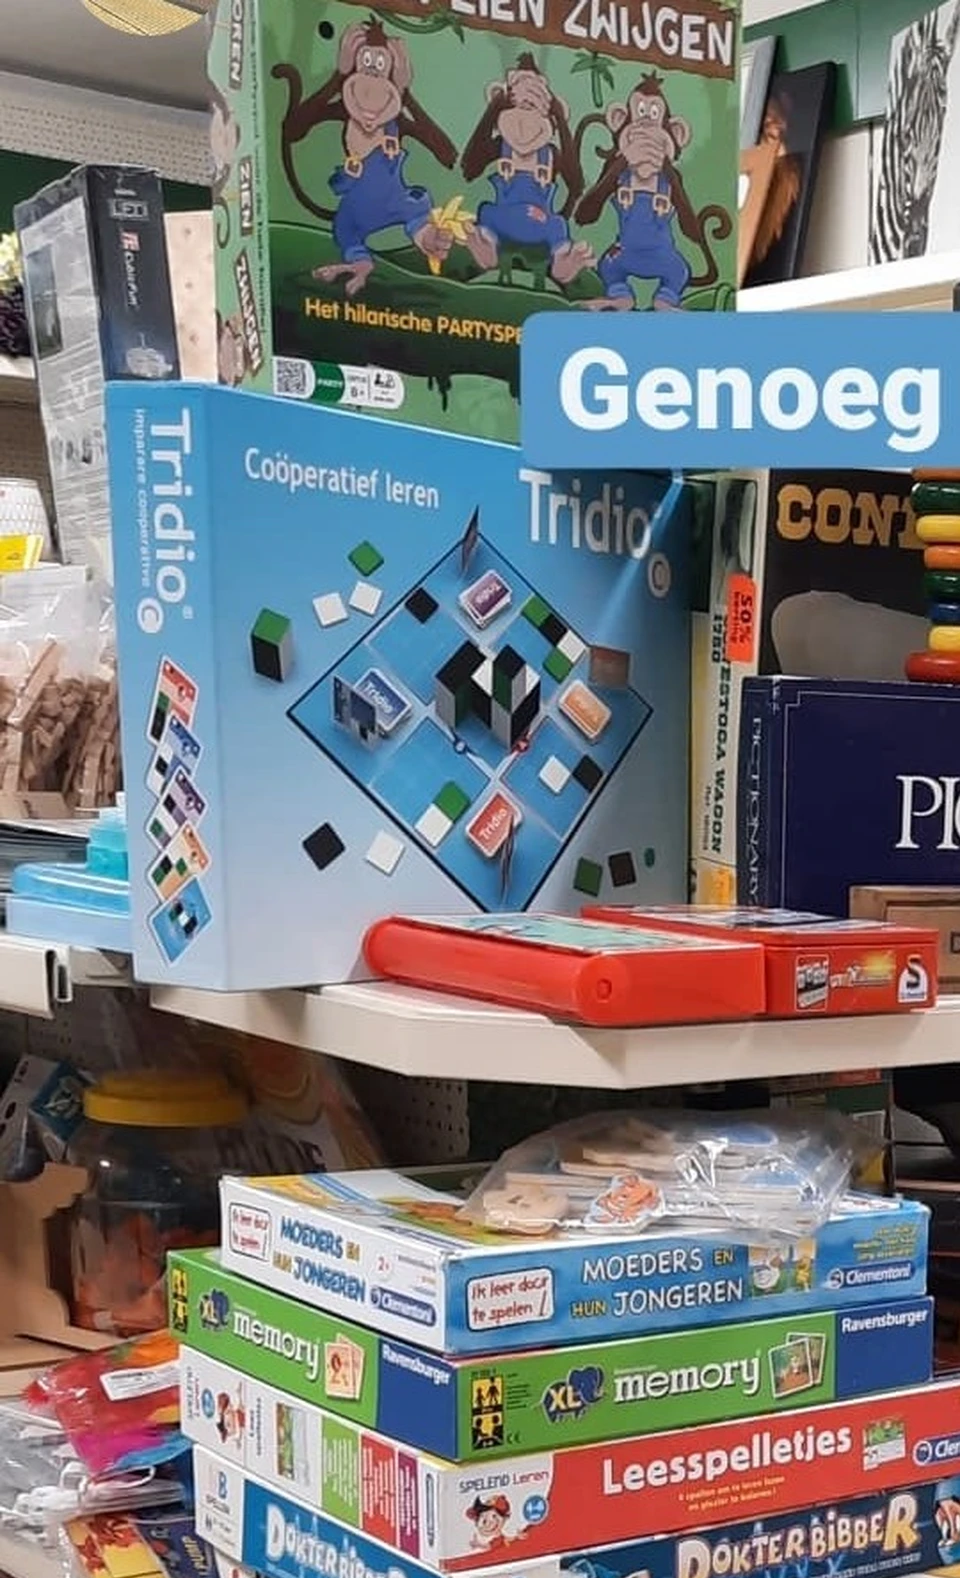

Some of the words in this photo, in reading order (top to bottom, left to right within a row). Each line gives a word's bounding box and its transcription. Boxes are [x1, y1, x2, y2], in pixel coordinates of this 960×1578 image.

[229, 0, 244, 83] OREN
[564, 0, 732, 66] ZWIJGEN
[240, 159, 251, 230] ZIEN
[305, 297, 340, 320] Het
[344, 303, 433, 332] hilarische
[437, 316, 522, 344] PARTYSPE
[244, 447, 380, 499] Coöperatief
[386, 472, 439, 509] leren
[150, 407, 196, 603] Tridio
[519, 469, 652, 559] Tridio
[738, 592, 753, 643] 50%
[749, 717, 762, 905] PICTIONARY
[281, 1216, 344, 1260] MOEDERS
[294, 1256, 366, 1304] JONGEREN
[472, 1281, 486, 1300] Ik
[489, 1279, 515, 1299] leer
[582, 1248, 703, 1284] MOEDERS
[713, 1249, 733, 1266] EN
[846, 1264, 911, 1286] Clementoni
[472, 1308, 486, 1324] te
[489, 1302, 533, 1325] spelen
[571, 1302, 606, 1318] HUN
[613, 1278, 743, 1317] JONGEREN
[841, 1309, 928, 1334] Ravensburger
[233, 1311, 320, 1381] memory
[382, 1343, 450, 1385] Ravensburger
[549, 1386, 582, 1413] XL
[613, 1356, 761, 1405] memory
[459, 1473, 509, 1495] SPELEND
[512, 1468, 549, 1488] Leren
[603, 1424, 852, 1496] Leesspelletjes
